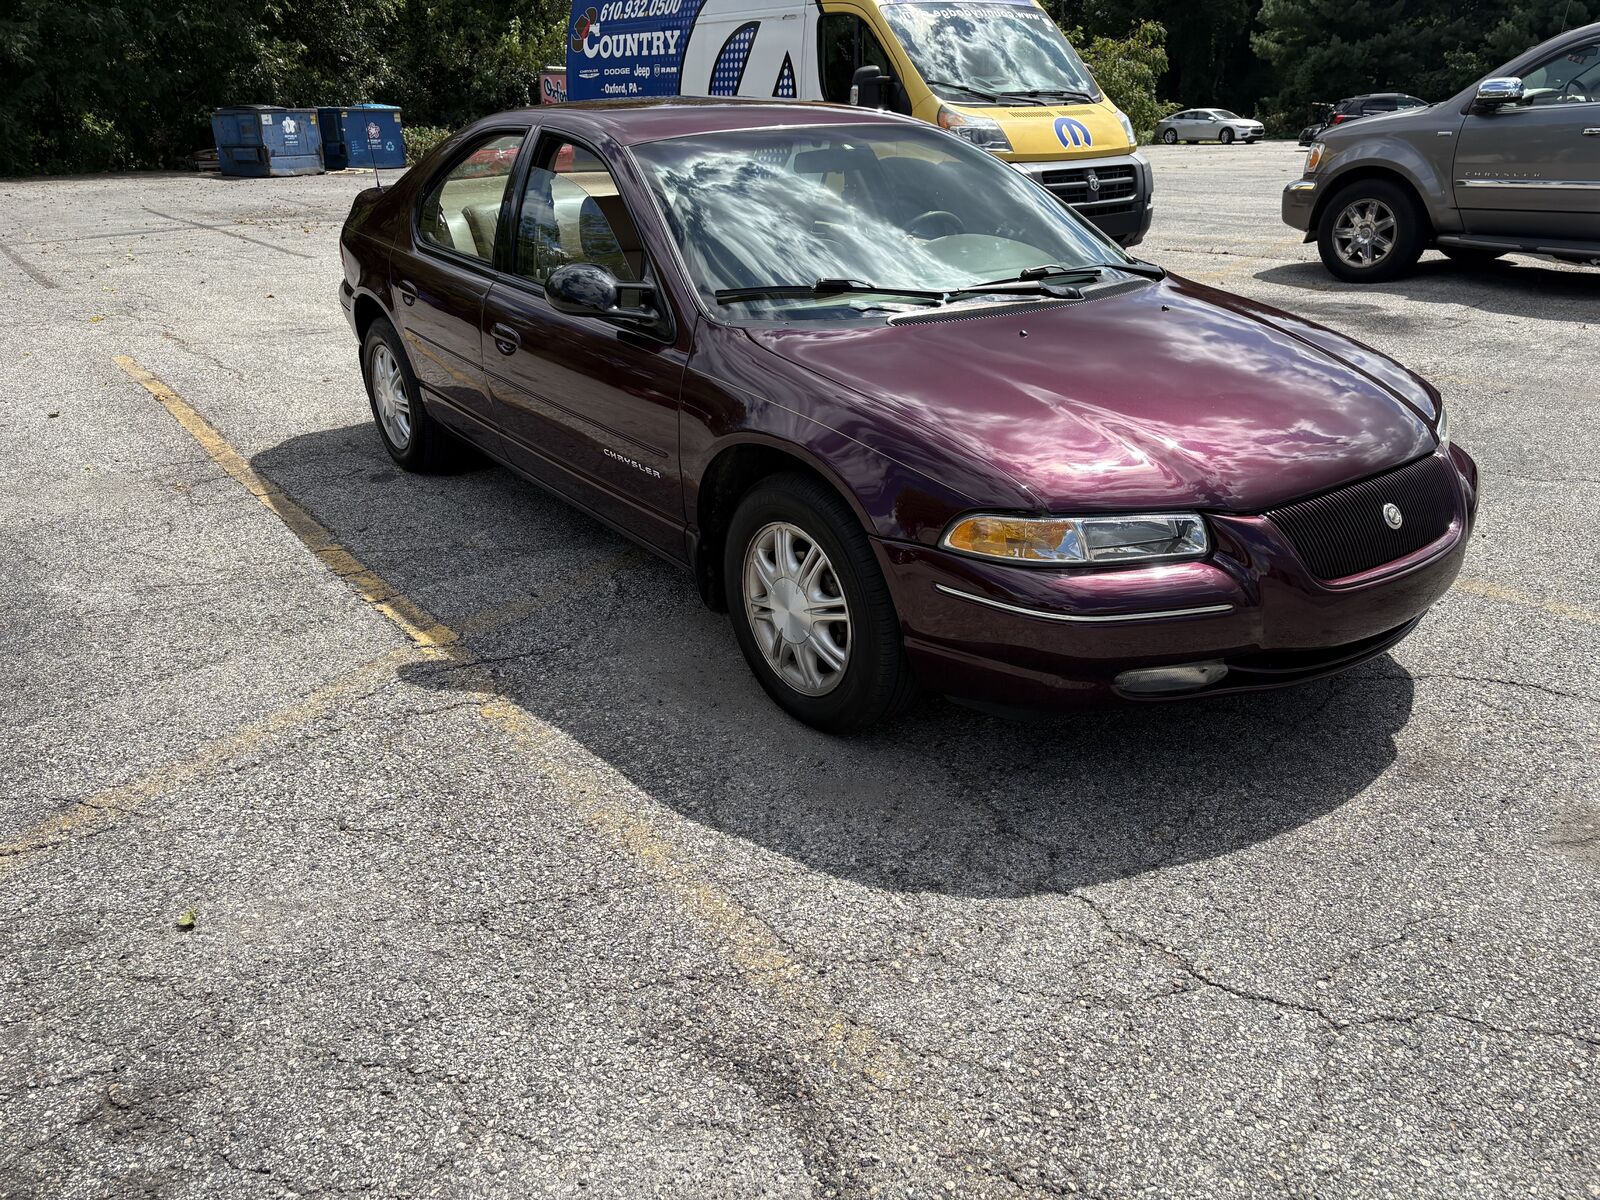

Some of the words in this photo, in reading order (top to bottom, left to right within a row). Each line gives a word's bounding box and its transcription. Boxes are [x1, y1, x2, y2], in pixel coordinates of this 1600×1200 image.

[600, 0, 682, 22] 610.932.0500
[583, 23, 681, 59] COUNTRY
[604, 67, 631, 76] DODGE
[633, 63, 651, 79] Jeep
[603, 448, 661, 479] CHRYSLER
